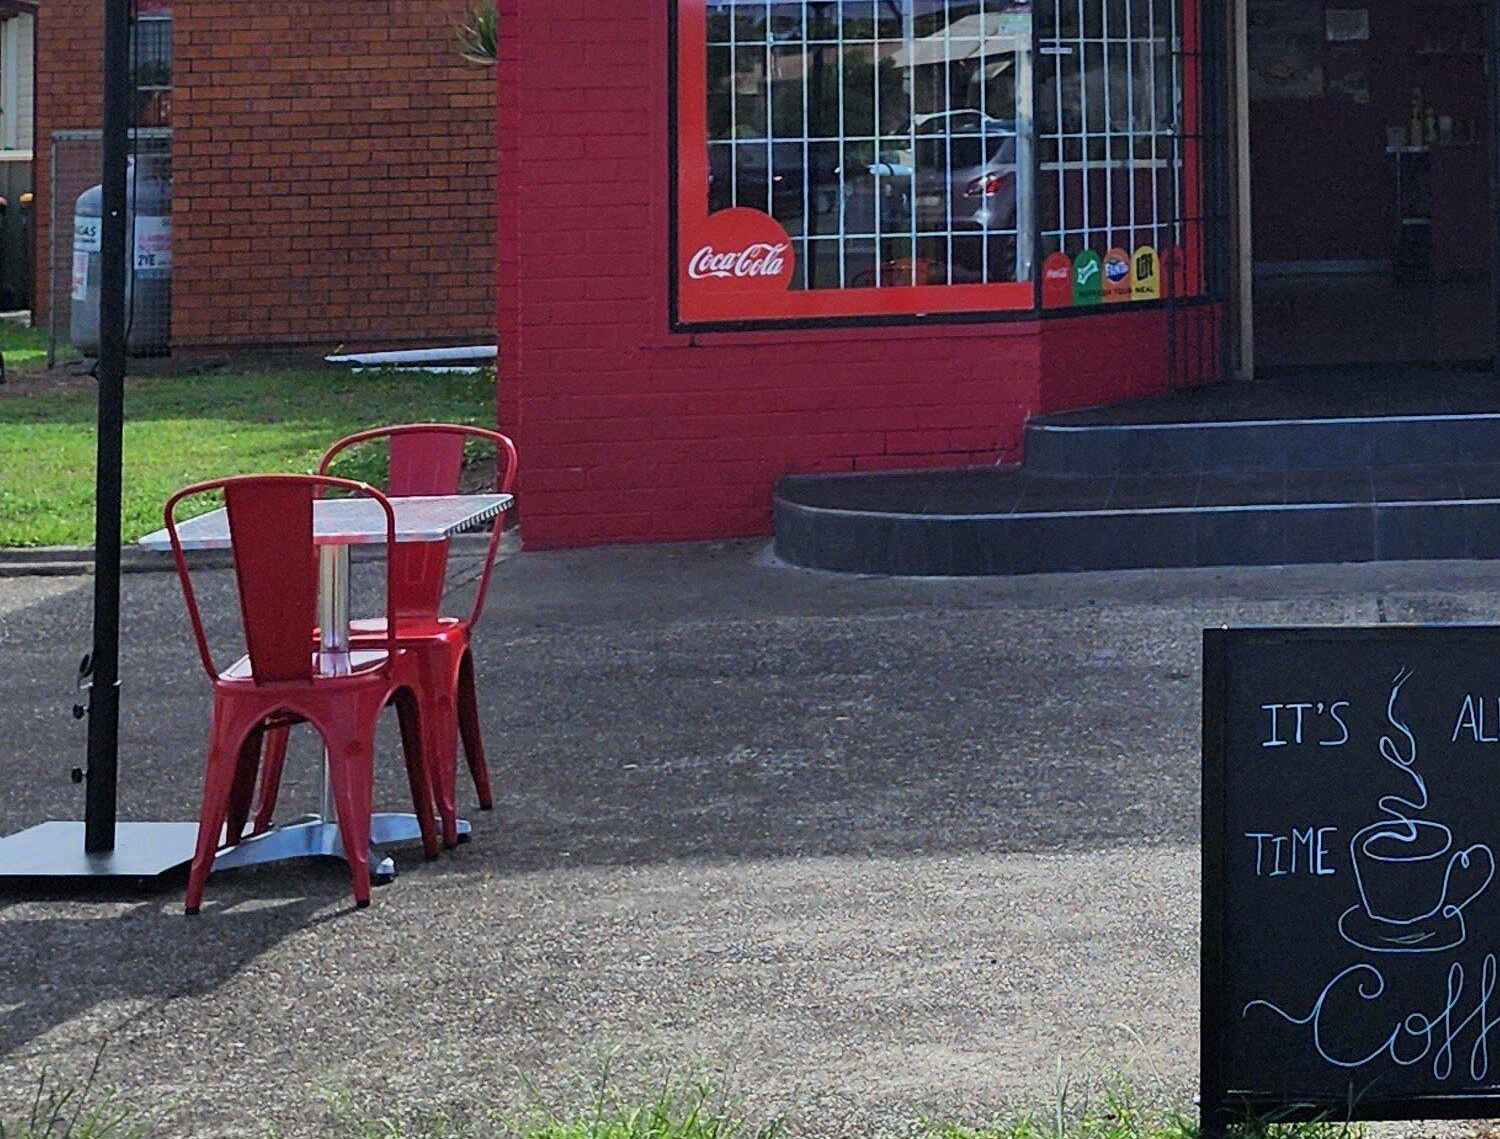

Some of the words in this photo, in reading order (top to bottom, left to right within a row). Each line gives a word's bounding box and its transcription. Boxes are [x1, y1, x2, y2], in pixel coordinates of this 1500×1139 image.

[688, 243, 790, 280] Coca-Cola
[1261, 701, 1350, 747] IT'S
[1244, 826, 1338, 876] TIME
